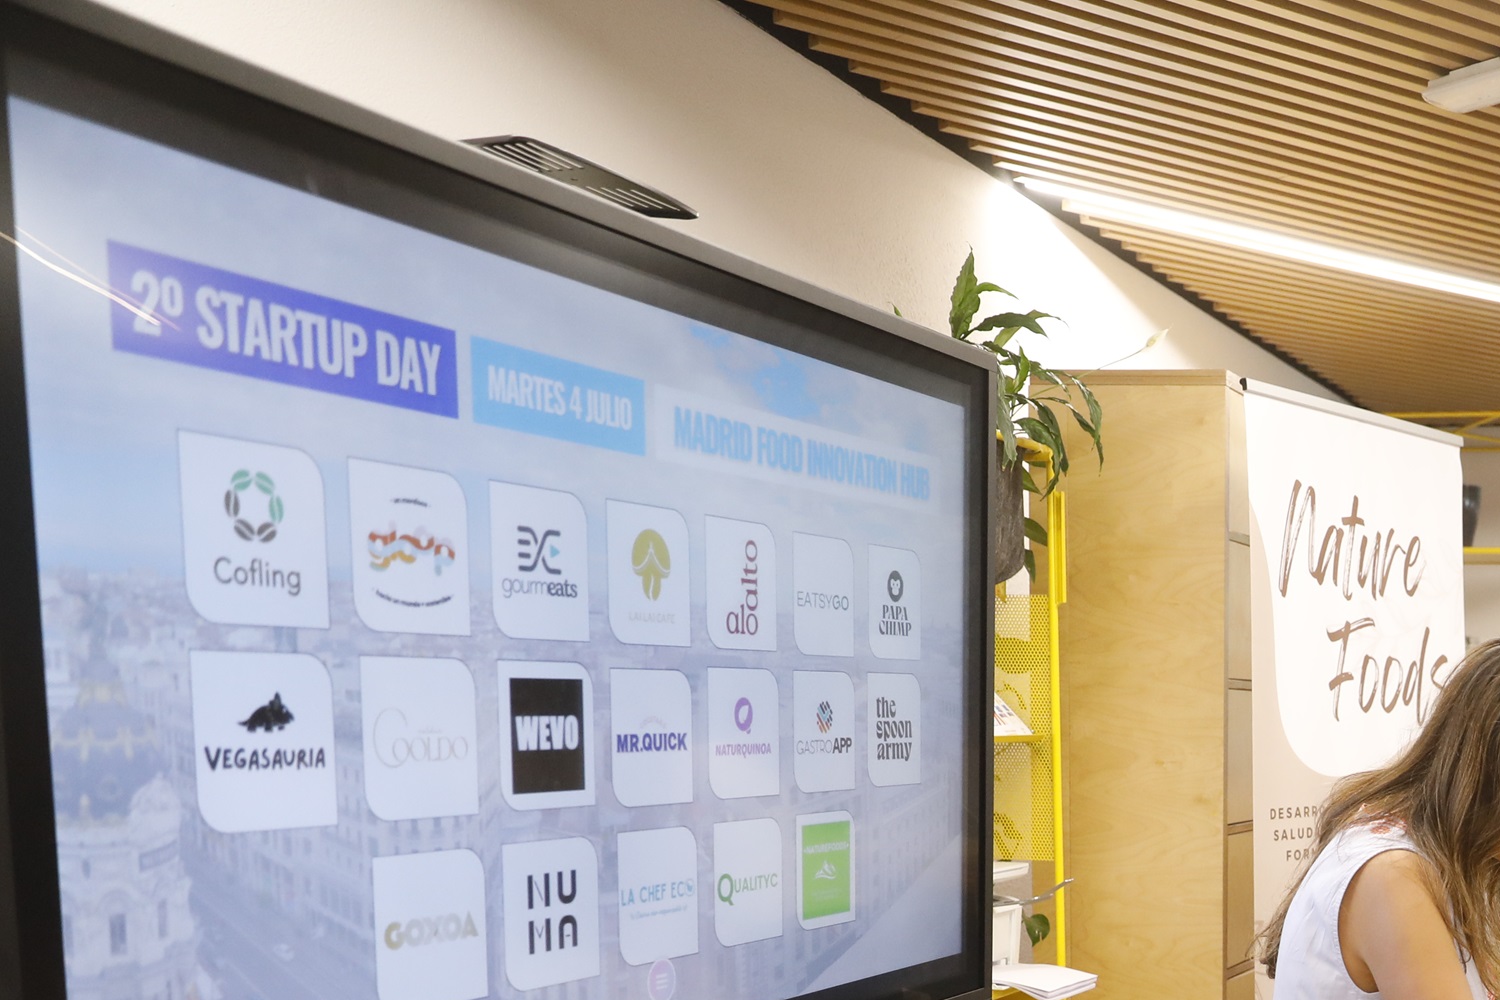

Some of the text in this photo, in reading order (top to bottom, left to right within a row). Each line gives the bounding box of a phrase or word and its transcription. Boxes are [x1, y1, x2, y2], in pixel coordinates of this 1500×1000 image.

[195, 285, 368, 379] STARTUP
[376, 329, 442, 396] DAY
[488, 364, 633, 431] MARTES 4 JULIO
[673, 406, 931, 501] MADRID FOOD INNOVATION HUB
[1278, 478, 1426, 601] Nature
[213, 556, 301, 597] Cofling
[501, 576, 578, 600] gourmeats
[740, 540, 758, 611] alto
[796, 590, 849, 611] EATSYGO
[882, 604, 908, 621] PAPA
[726, 604, 758, 635] alo
[879, 620, 912, 637] CHIMP
[1326, 616, 1449, 727] Foods
[876, 697, 896, 718] the
[515, 714, 579, 752] WEVO
[616, 732, 688, 753] MR.QUICK
[876, 720, 913, 741] spoon
[204, 745, 326, 772] VEGASAURIA
[715, 742, 772, 758] NATURQUINOA
[796, 738, 852, 755] GASTROAPP
[877, 742, 913, 761] army
[1273, 827, 1313, 841] SALUD
[527, 869, 577, 910] NU
[621, 888, 635, 906] LA
[639, 883, 666, 903] CHEF
[384, 911, 479, 951] GOXOA
[529, 914, 578, 955] MA
